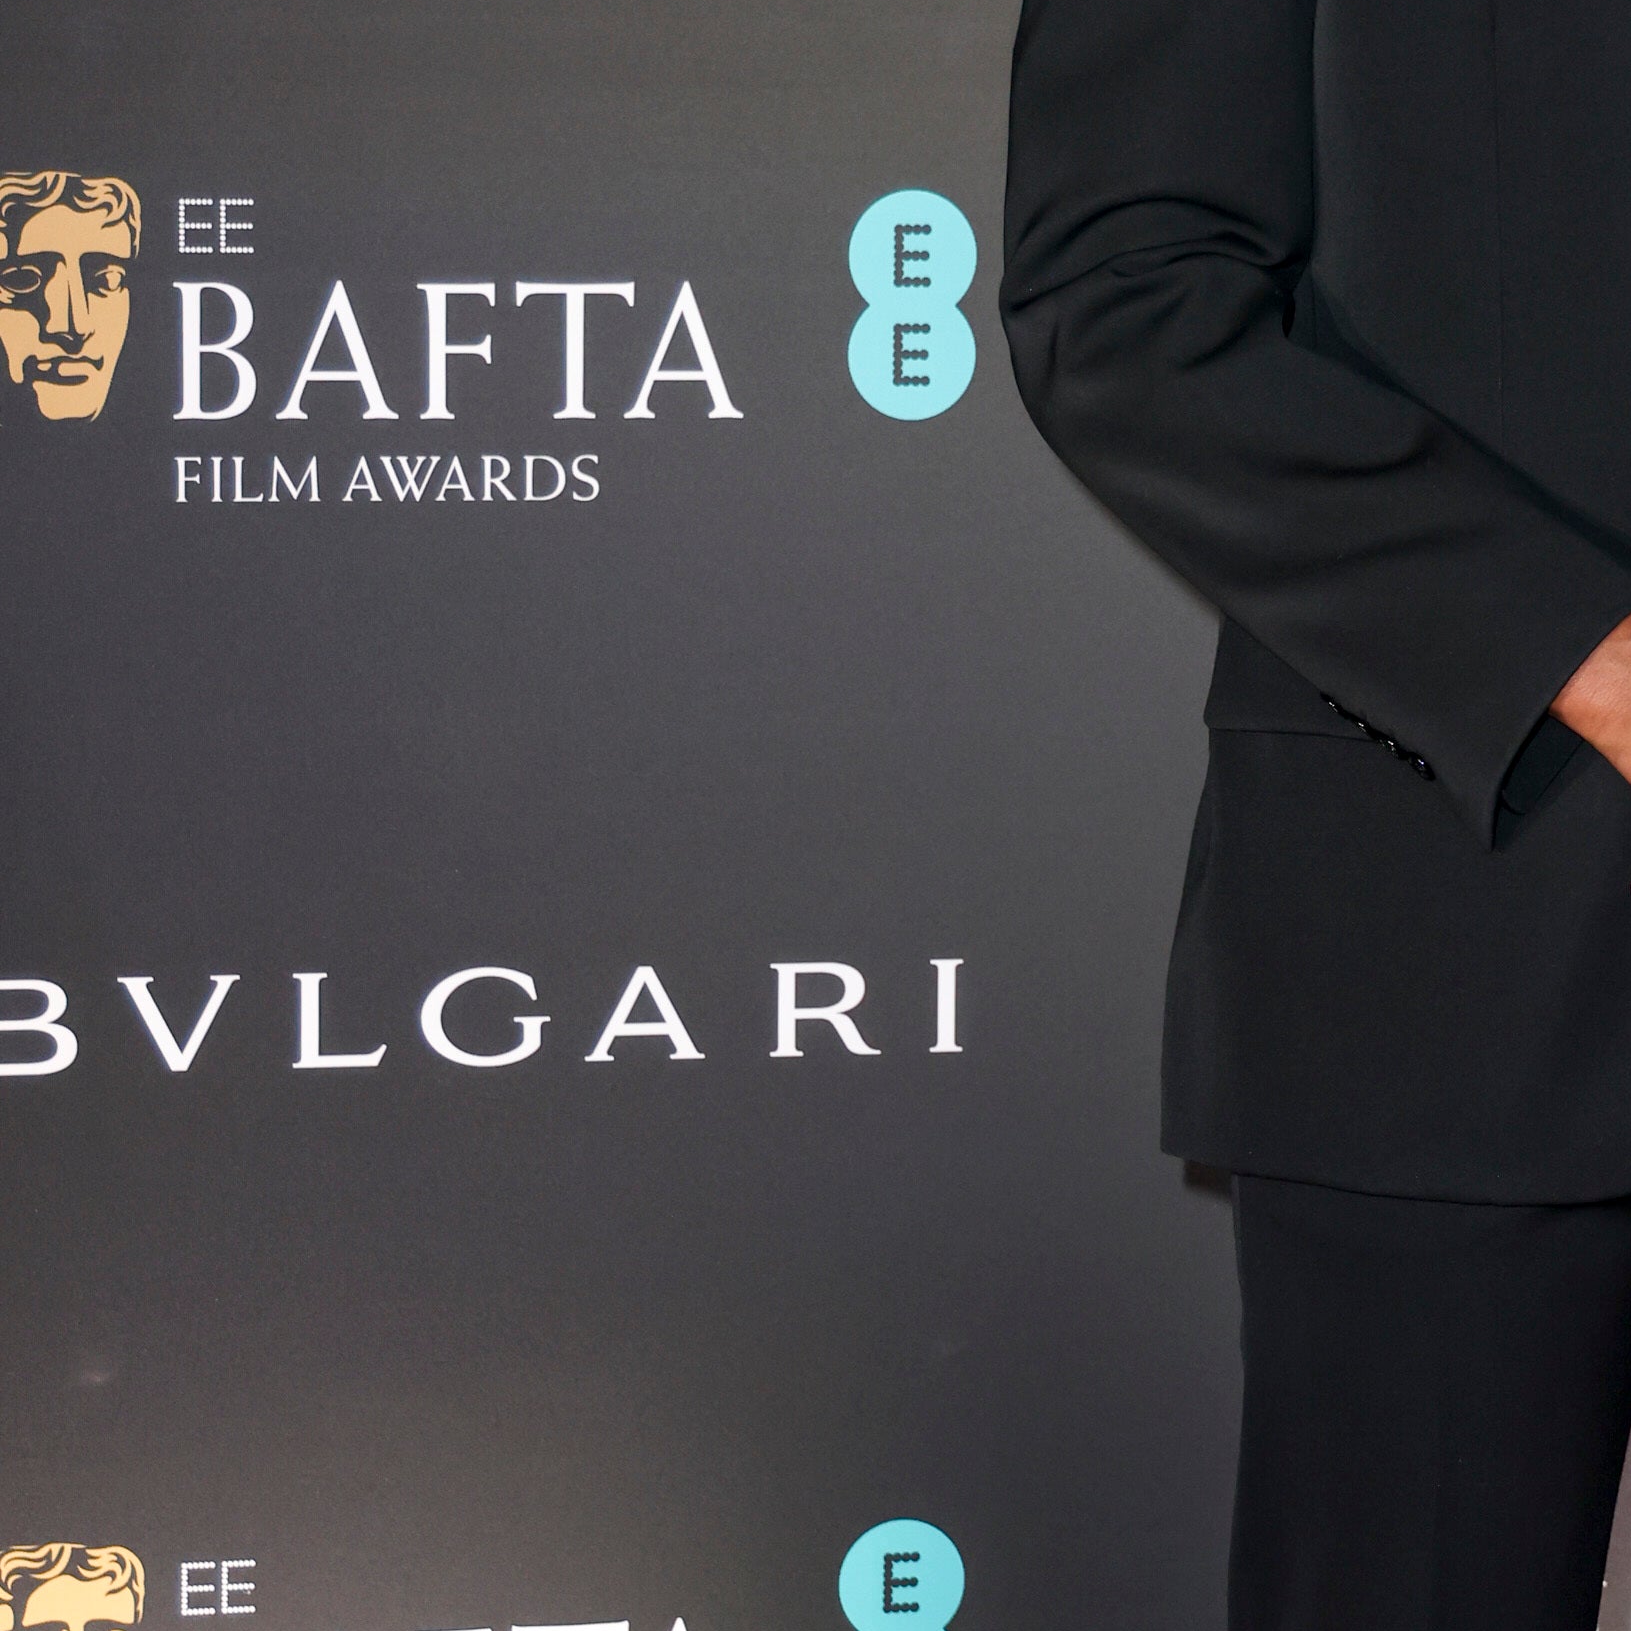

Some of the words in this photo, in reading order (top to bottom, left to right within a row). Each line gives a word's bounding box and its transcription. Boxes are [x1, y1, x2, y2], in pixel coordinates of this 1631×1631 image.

[179, 199, 254, 253] EE
[173, 280, 743, 419] BAFTA
[175, 456, 320, 502] FILM
[343, 455, 599, 501] AWARDS
[0, 959, 963, 1076] BVLGARI
[181, 1560, 256, 1616] EE
